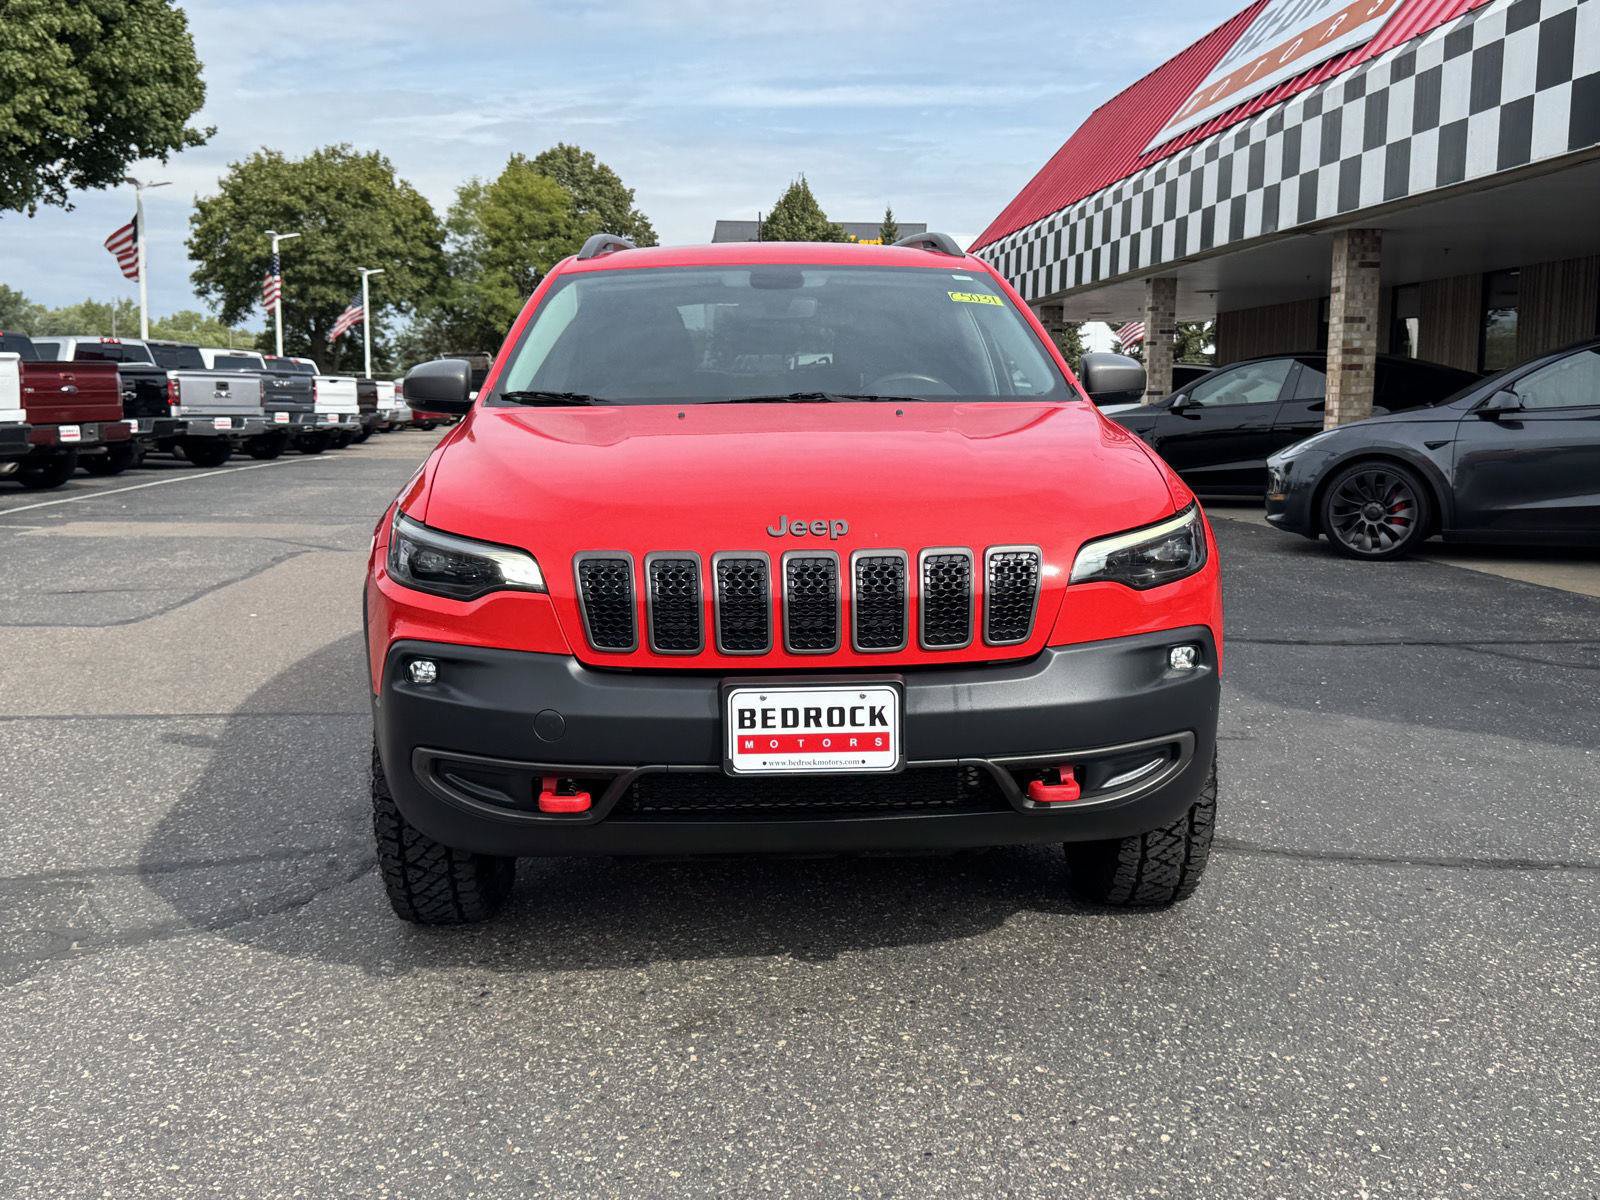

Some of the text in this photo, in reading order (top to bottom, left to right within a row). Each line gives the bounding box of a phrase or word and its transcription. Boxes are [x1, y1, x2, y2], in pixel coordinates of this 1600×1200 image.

[1216, 0, 1332, 70] BED
[766, 514, 849, 541] Jeep
[737, 705, 889, 729] BEDROCK
[744, 737, 883, 749] MOTORS
[768, 758, 860, 767] www.bedrockmotors.com
